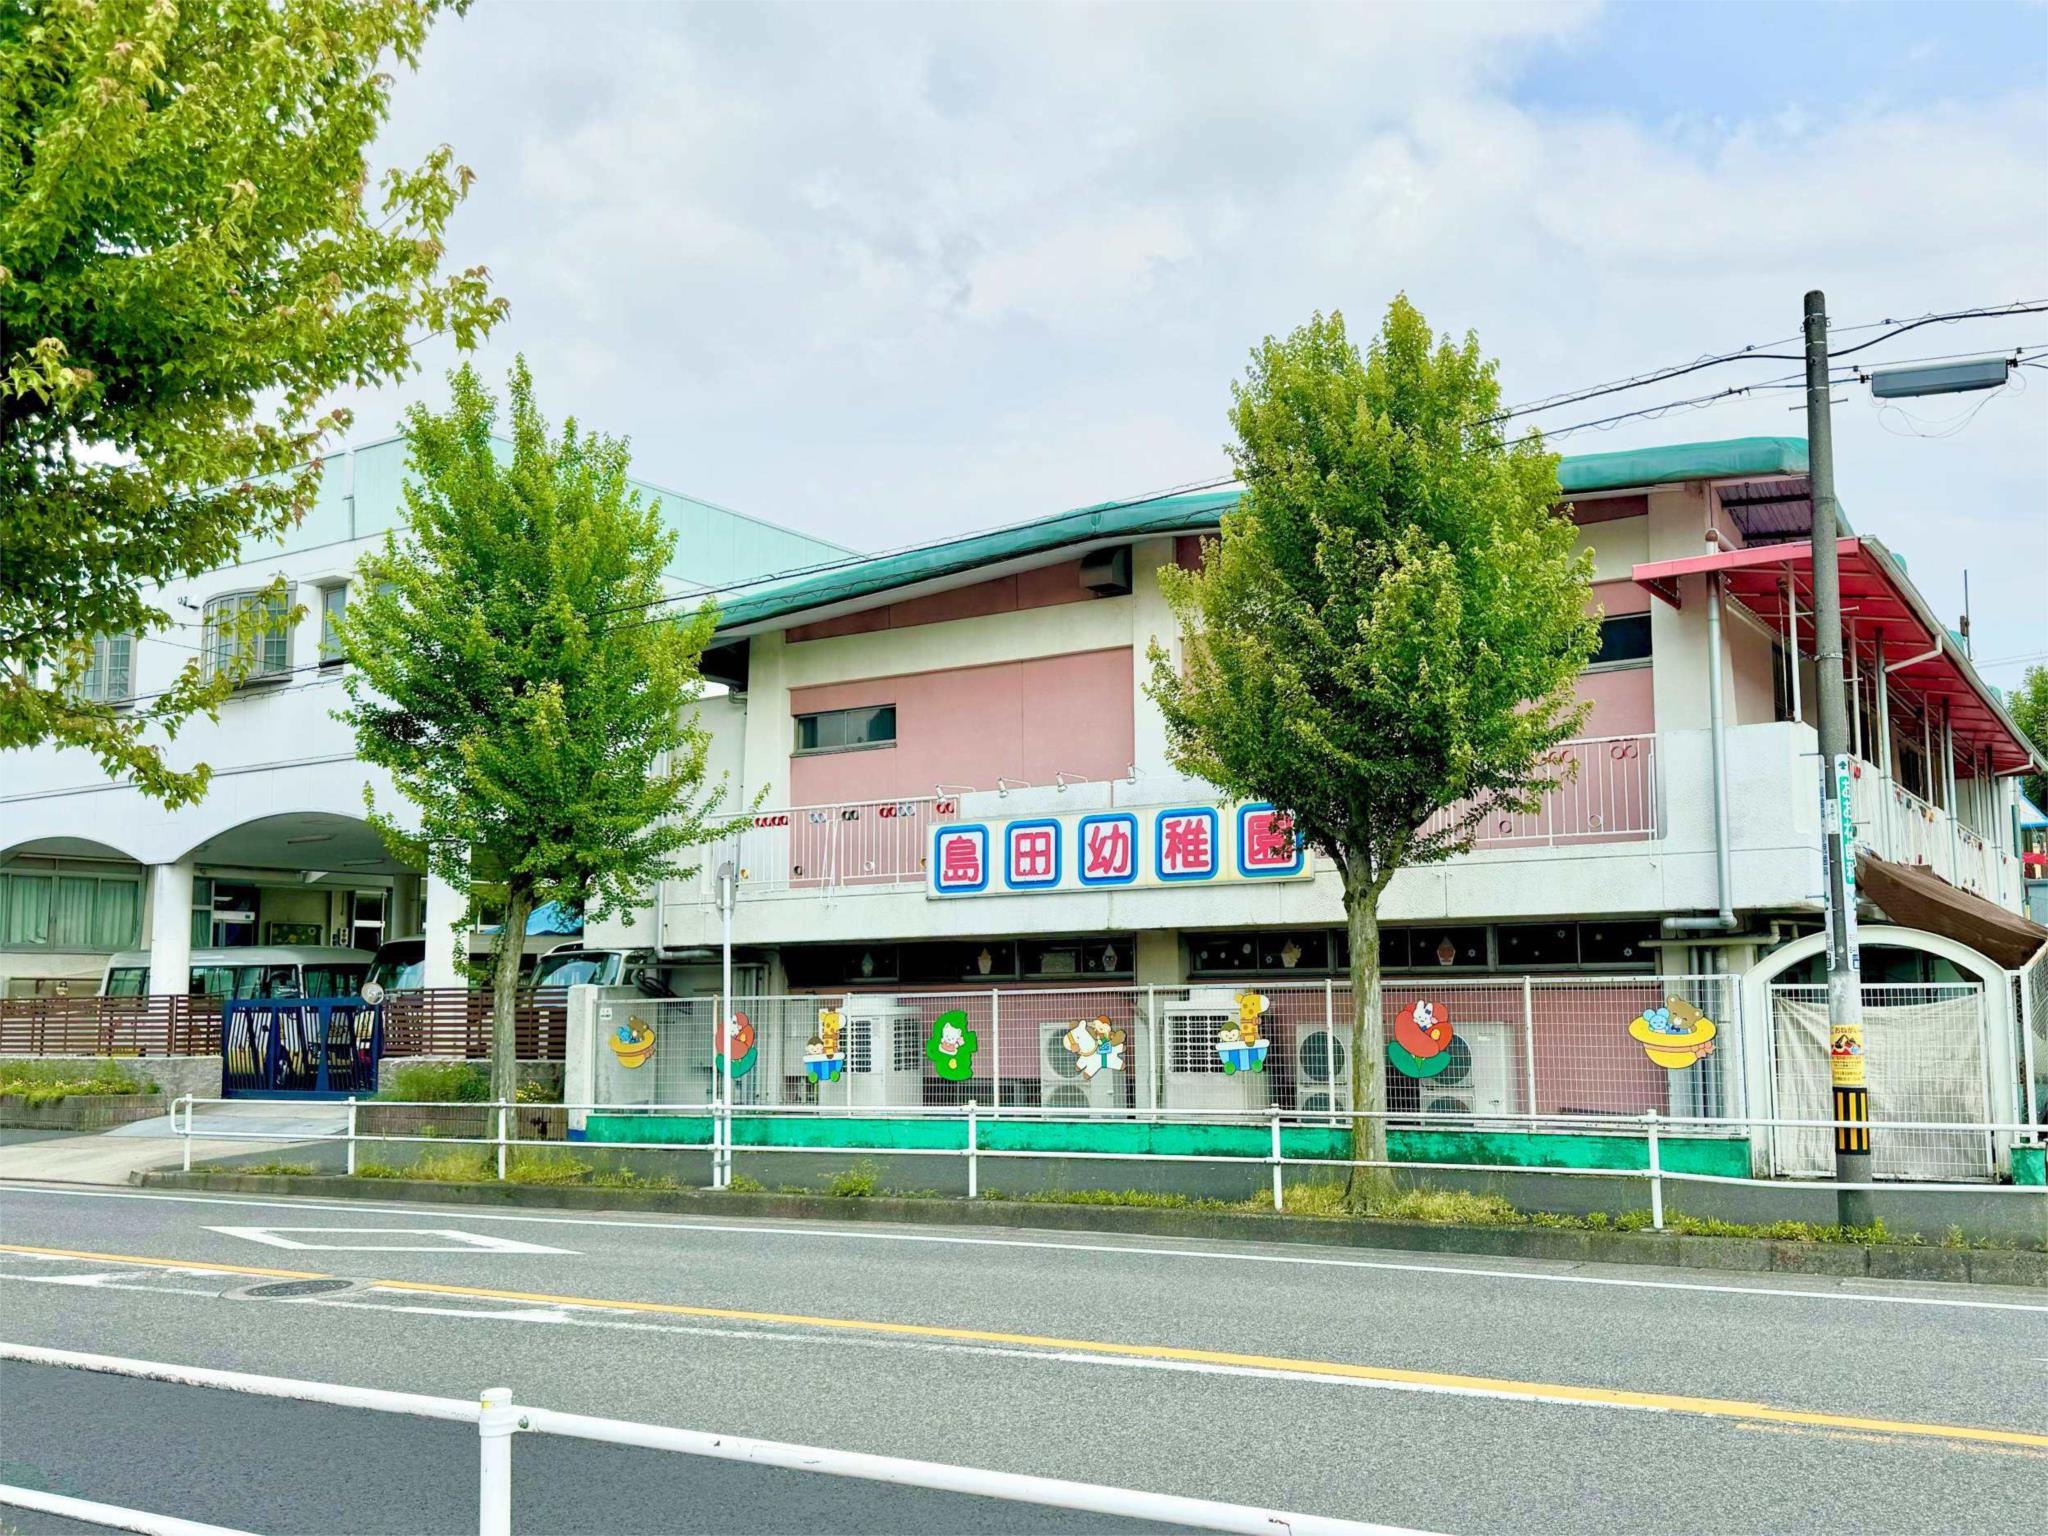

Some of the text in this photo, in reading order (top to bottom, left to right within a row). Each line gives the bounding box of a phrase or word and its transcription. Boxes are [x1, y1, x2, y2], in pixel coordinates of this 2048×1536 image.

[943, 814, 1293, 883] 島田幼稚園
